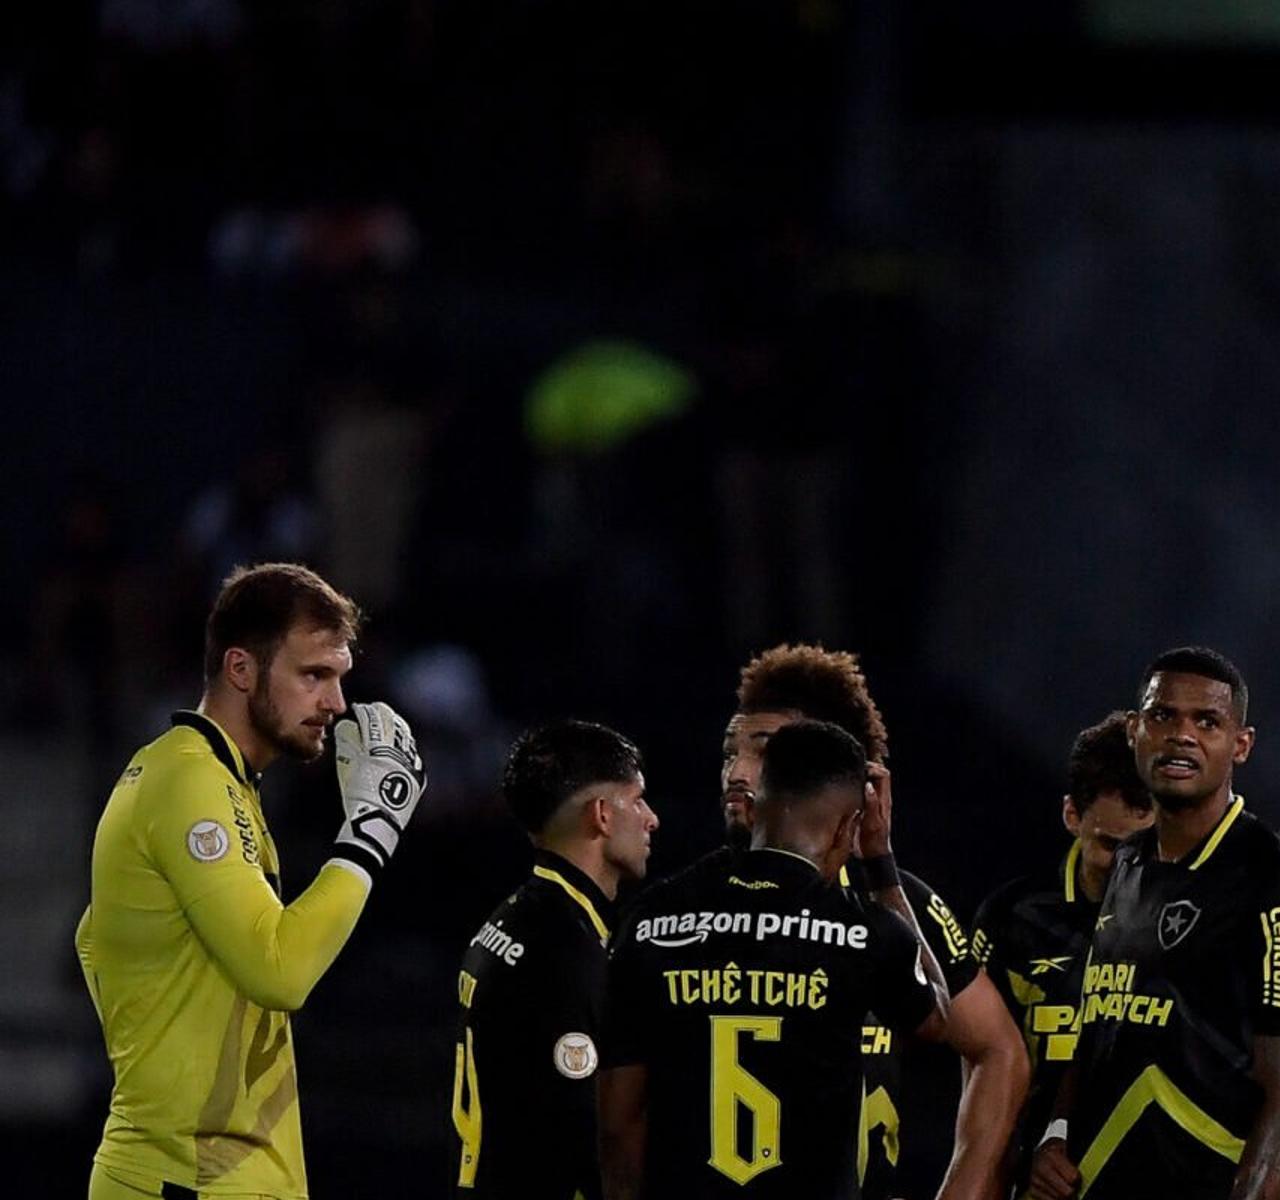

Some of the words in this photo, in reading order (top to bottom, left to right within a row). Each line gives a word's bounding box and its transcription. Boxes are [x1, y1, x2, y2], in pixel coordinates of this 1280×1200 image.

[635, 911, 752, 943] amazon
[755, 908, 870, 949] prime
[662, 960, 742, 1006] TCHÊ
[745, 966, 831, 1011] TCHÊ
[707, 1014, 784, 1187] 6
